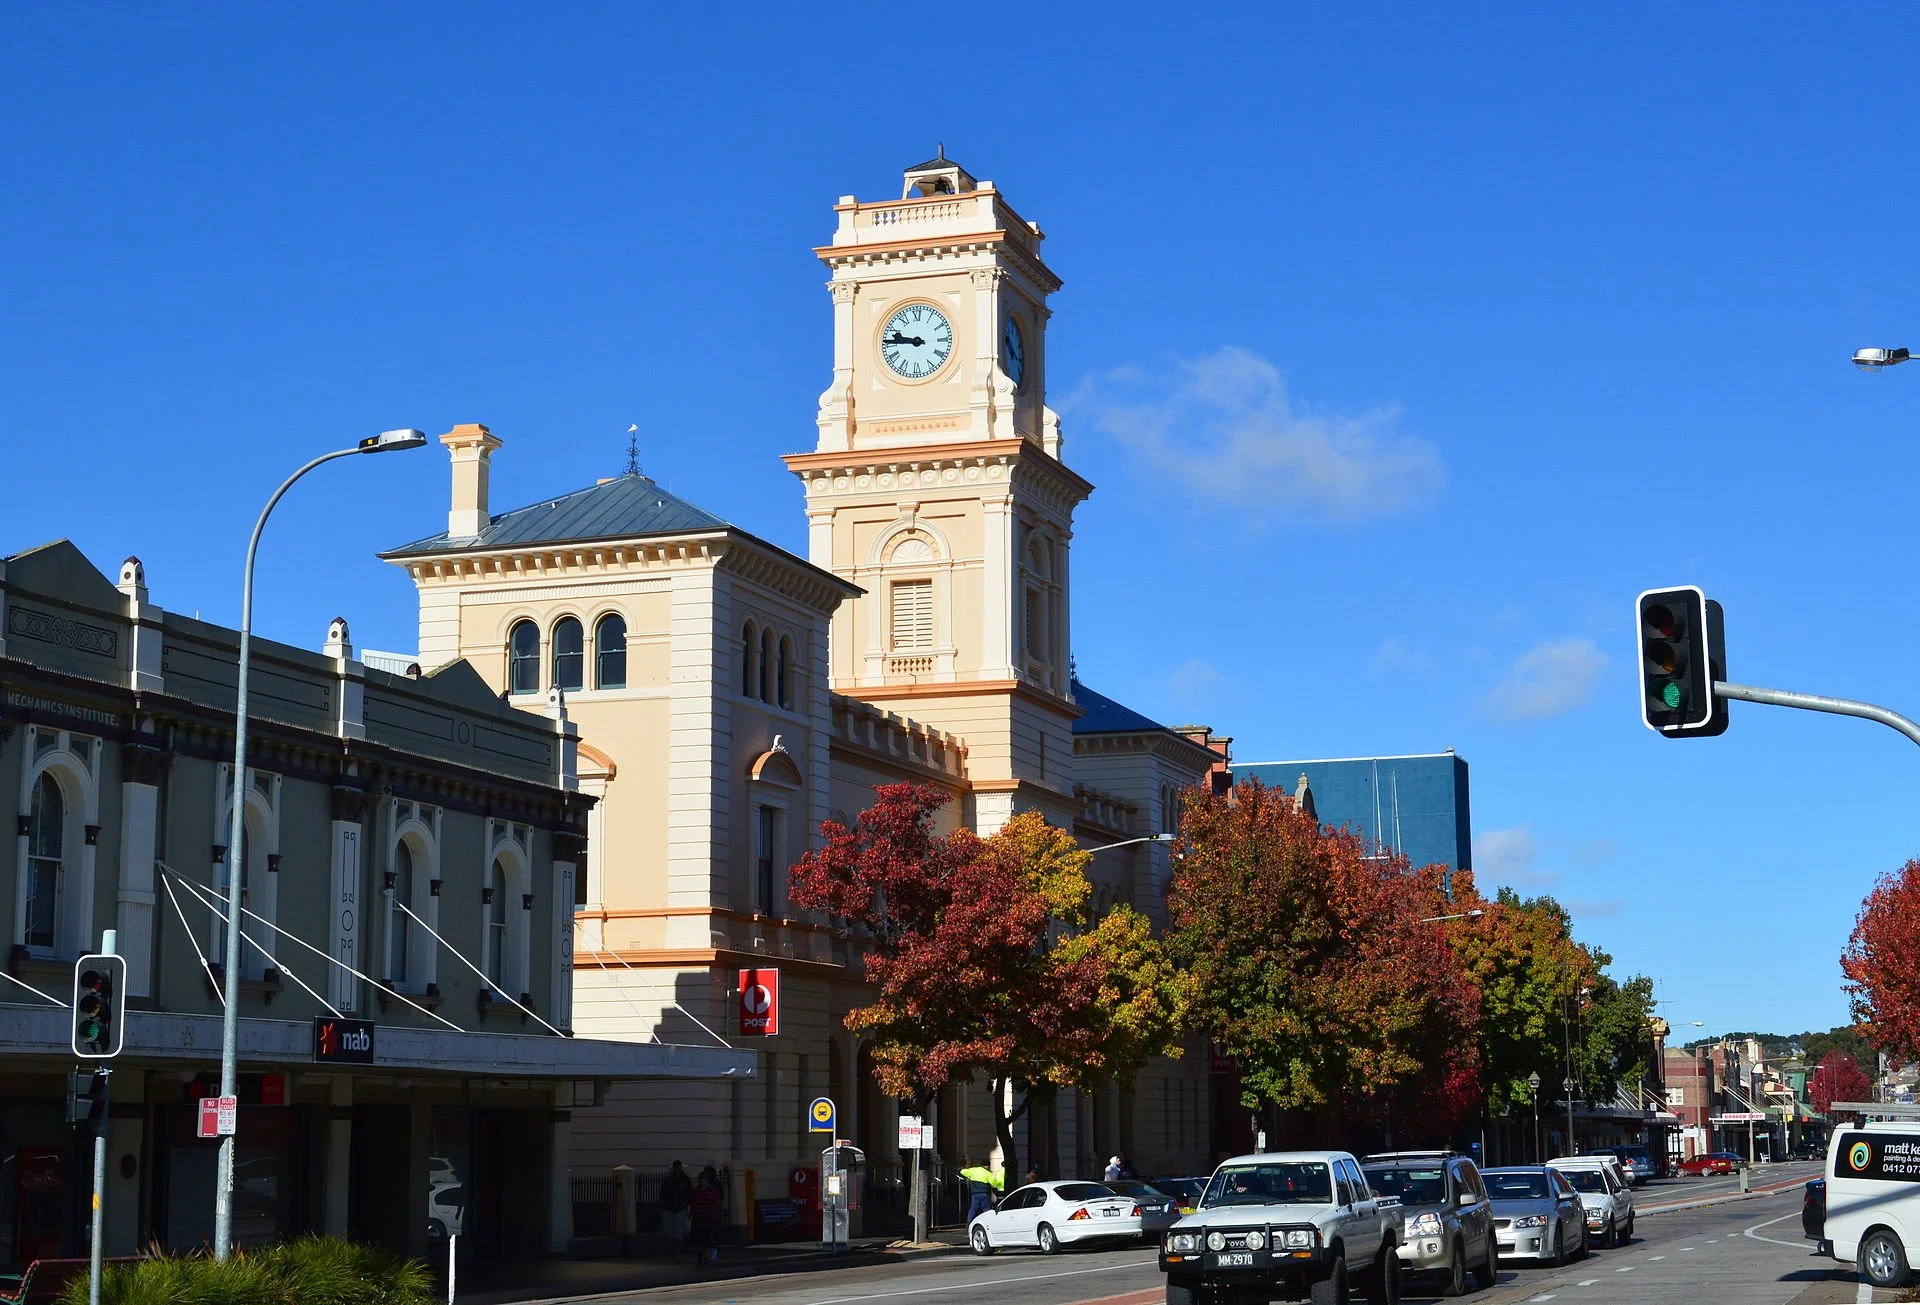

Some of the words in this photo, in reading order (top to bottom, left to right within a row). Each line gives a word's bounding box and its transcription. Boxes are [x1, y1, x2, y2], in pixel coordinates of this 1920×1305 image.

[744, 1017, 772, 1027] POST
[342, 1028, 370, 1052] nab
[1884, 1142, 1910, 1154] matt
[1883, 1155, 1907, 1163] painting
[1882, 1163, 1905, 1173] 0412
